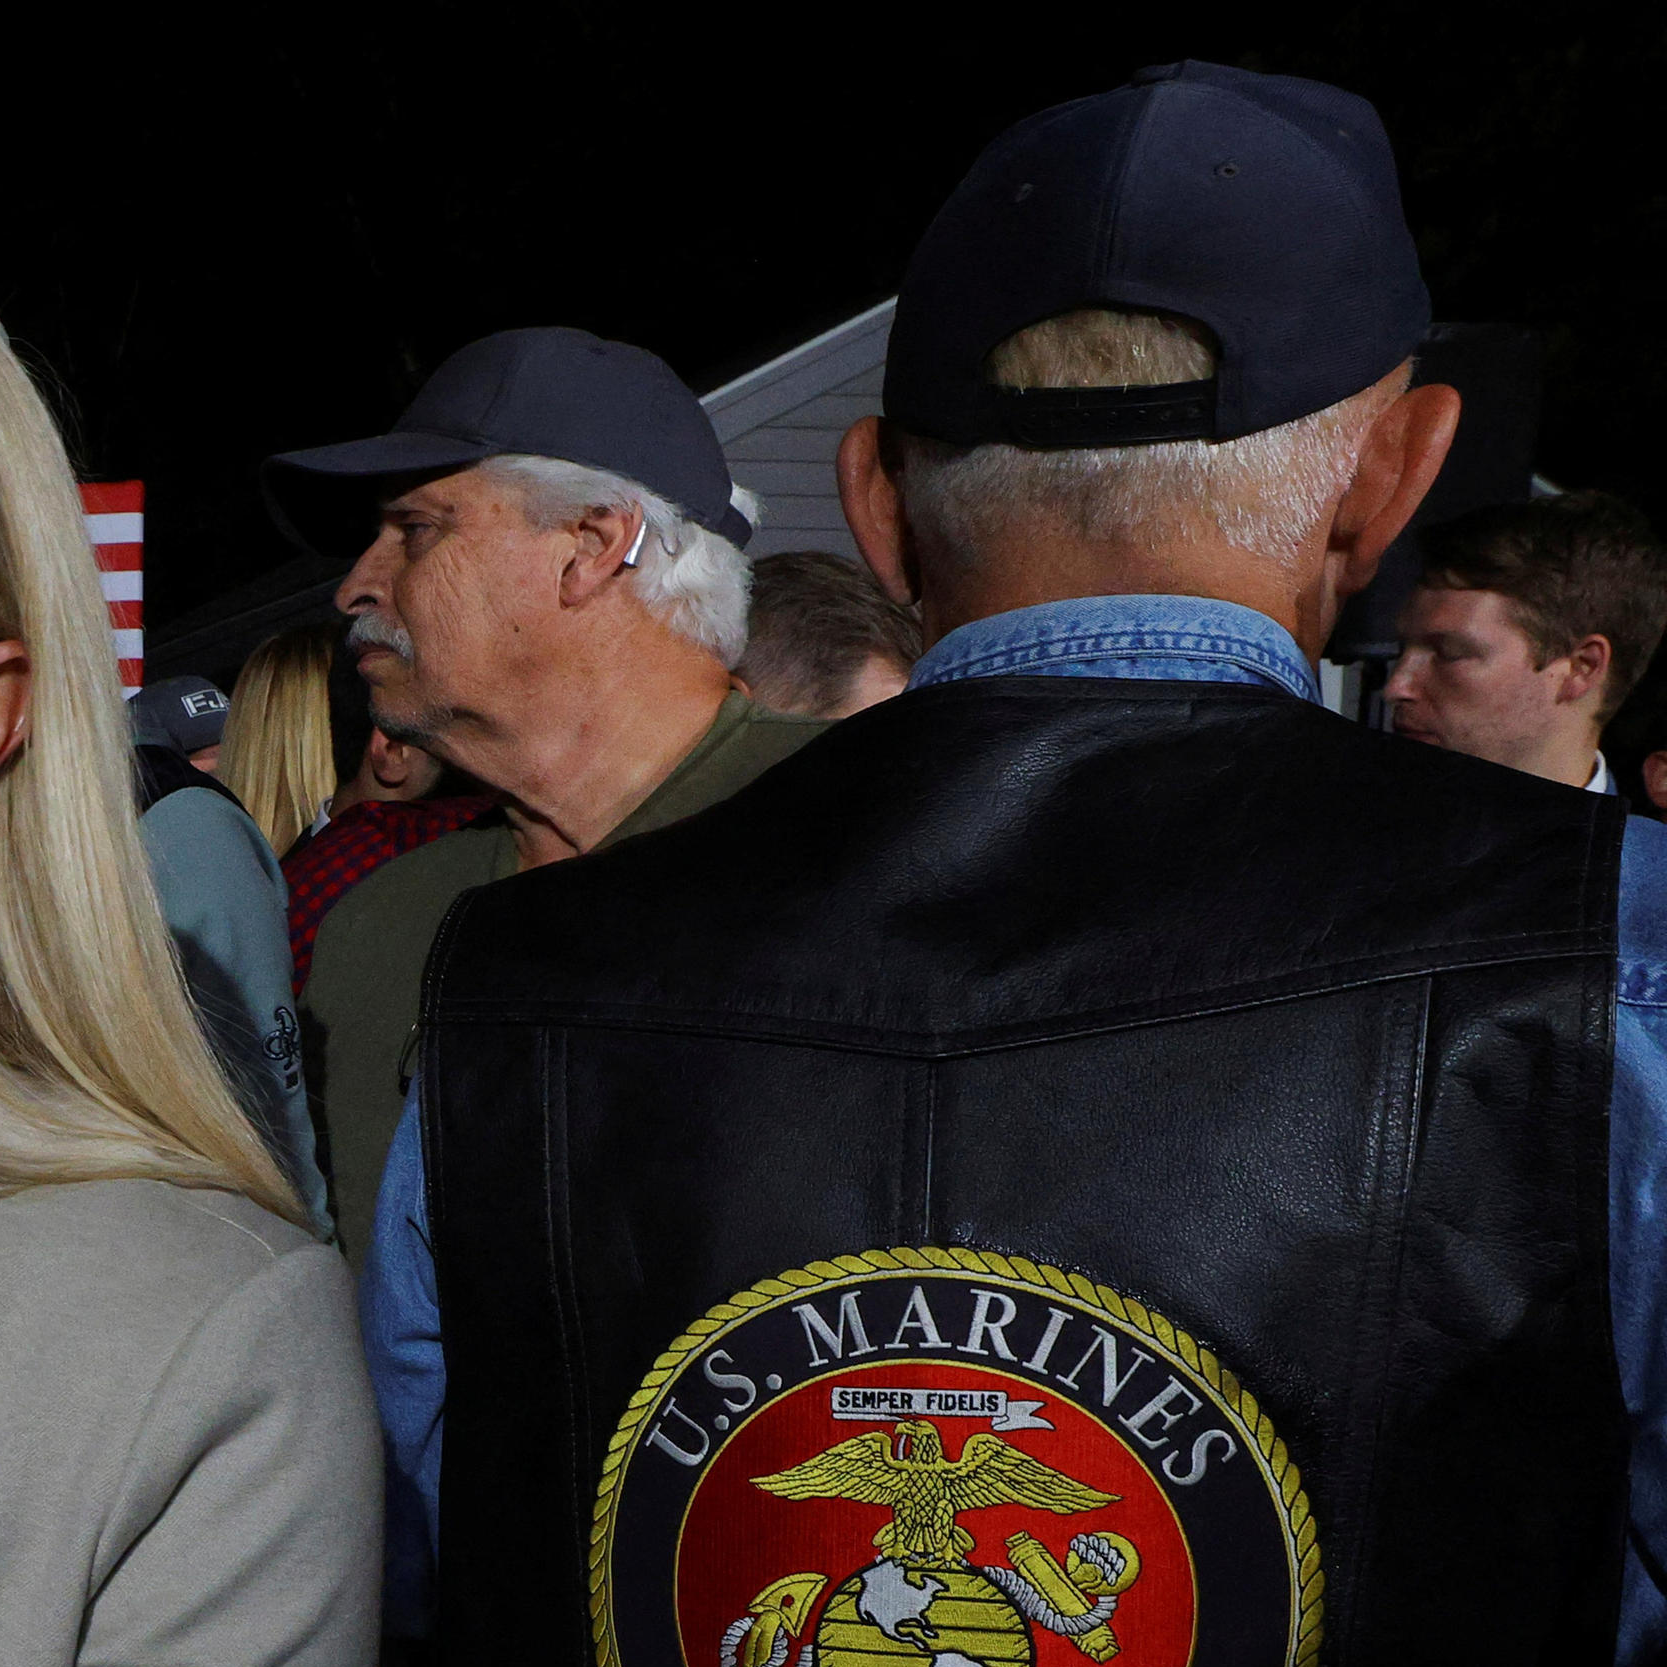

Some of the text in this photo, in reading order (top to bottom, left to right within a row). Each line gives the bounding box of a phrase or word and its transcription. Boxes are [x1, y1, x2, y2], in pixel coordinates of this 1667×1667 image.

[645, 1286, 1237, 1485] U.S. MARINES
[837, 1390, 1000, 1413] SEMPER FIDELIS
